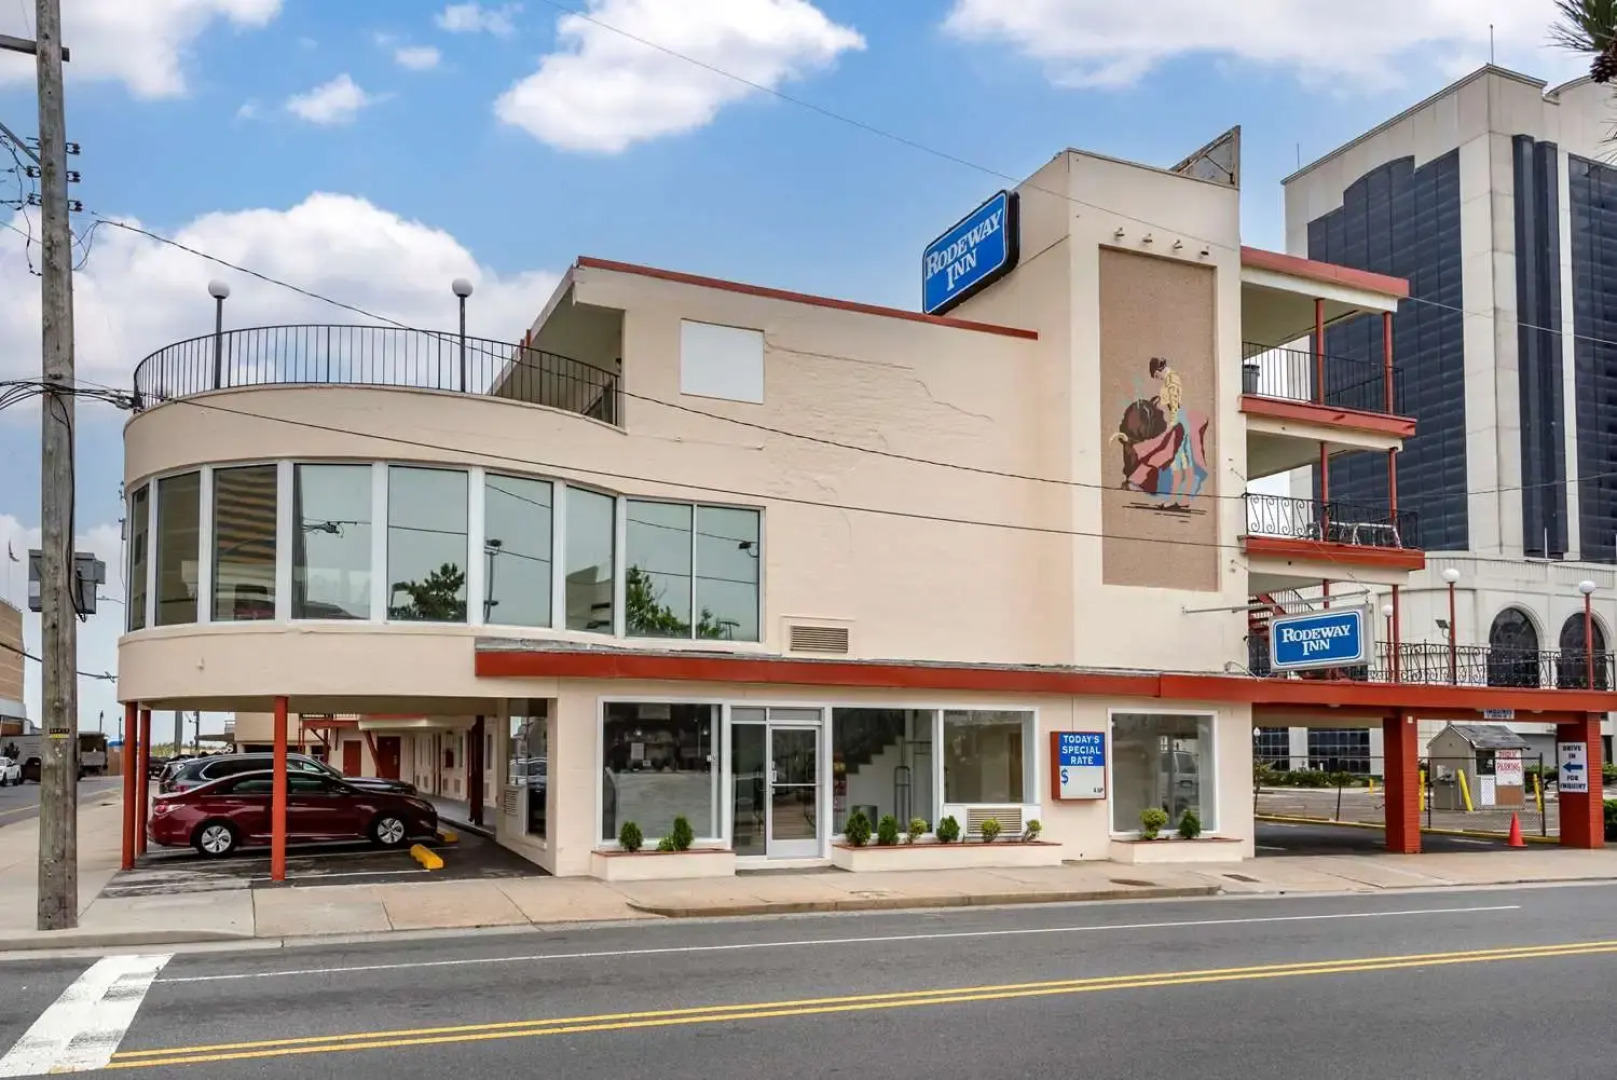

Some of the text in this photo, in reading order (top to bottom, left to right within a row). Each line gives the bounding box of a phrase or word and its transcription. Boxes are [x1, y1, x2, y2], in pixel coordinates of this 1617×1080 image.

[926, 208, 1002, 280] RODEWAY
[946, 248, 977, 291] INN
[1281, 625, 1351, 643] RODEWAY
[1302, 639, 1330, 656] INN
[1063, 735, 1100, 744] TODAY'S
[1062, 746, 1101, 754] SPECIAL
[1070, 756, 1094, 764] RATE
